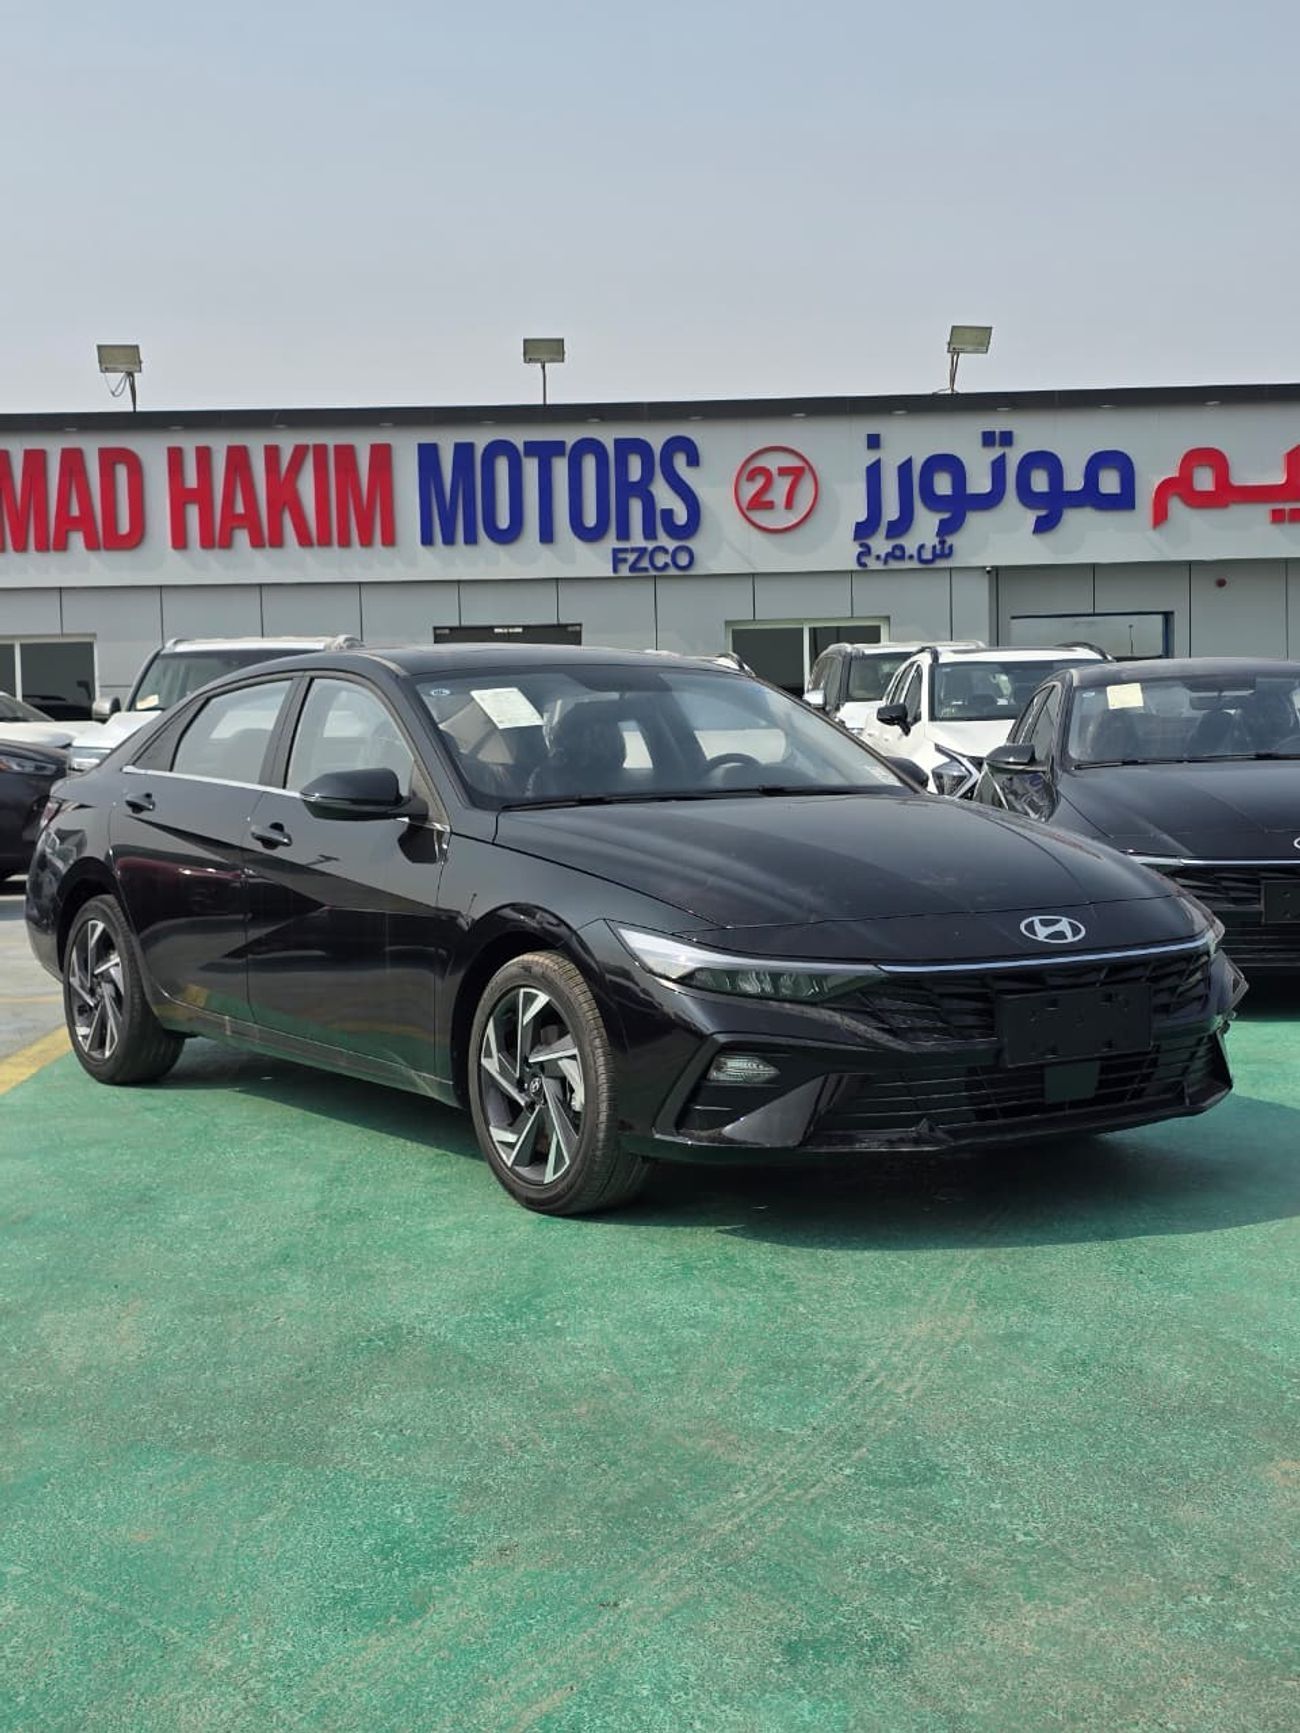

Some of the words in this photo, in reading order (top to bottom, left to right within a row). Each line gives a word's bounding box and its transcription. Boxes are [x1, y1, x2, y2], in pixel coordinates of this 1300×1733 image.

[0, 446, 145, 553] MAD
[167, 443, 396, 550] HAKIM
[417, 435, 700, 546] MOTORS
[745, 465, 806, 511] 27
[853, 430, 1137, 542] موتورز
[611, 546, 694, 573] FZCO
